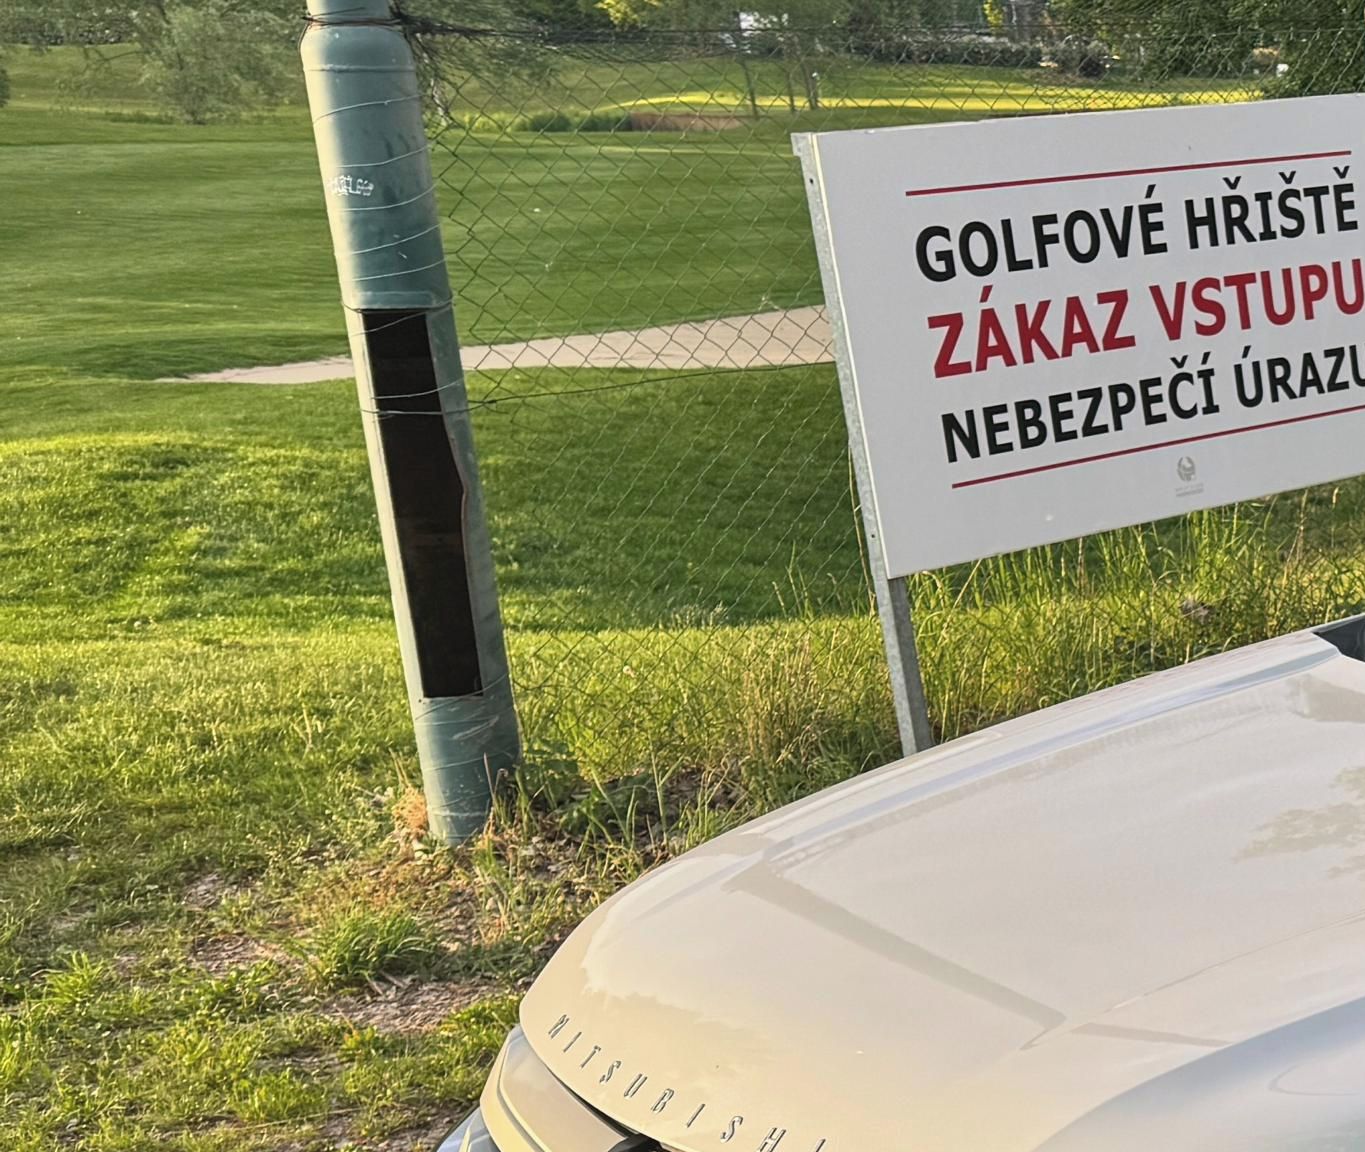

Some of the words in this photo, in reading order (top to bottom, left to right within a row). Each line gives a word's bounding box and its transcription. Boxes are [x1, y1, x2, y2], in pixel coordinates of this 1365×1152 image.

[915, 184, 1169, 283] GOLFOVÉ
[1184, 165, 1359, 249] HŘIŠTĚ
[927, 284, 1137, 379] ZÁKAZ
[1148, 258, 1365, 341] VSTUPU
[941, 351, 1220, 464] NEBEZPEČÍ
